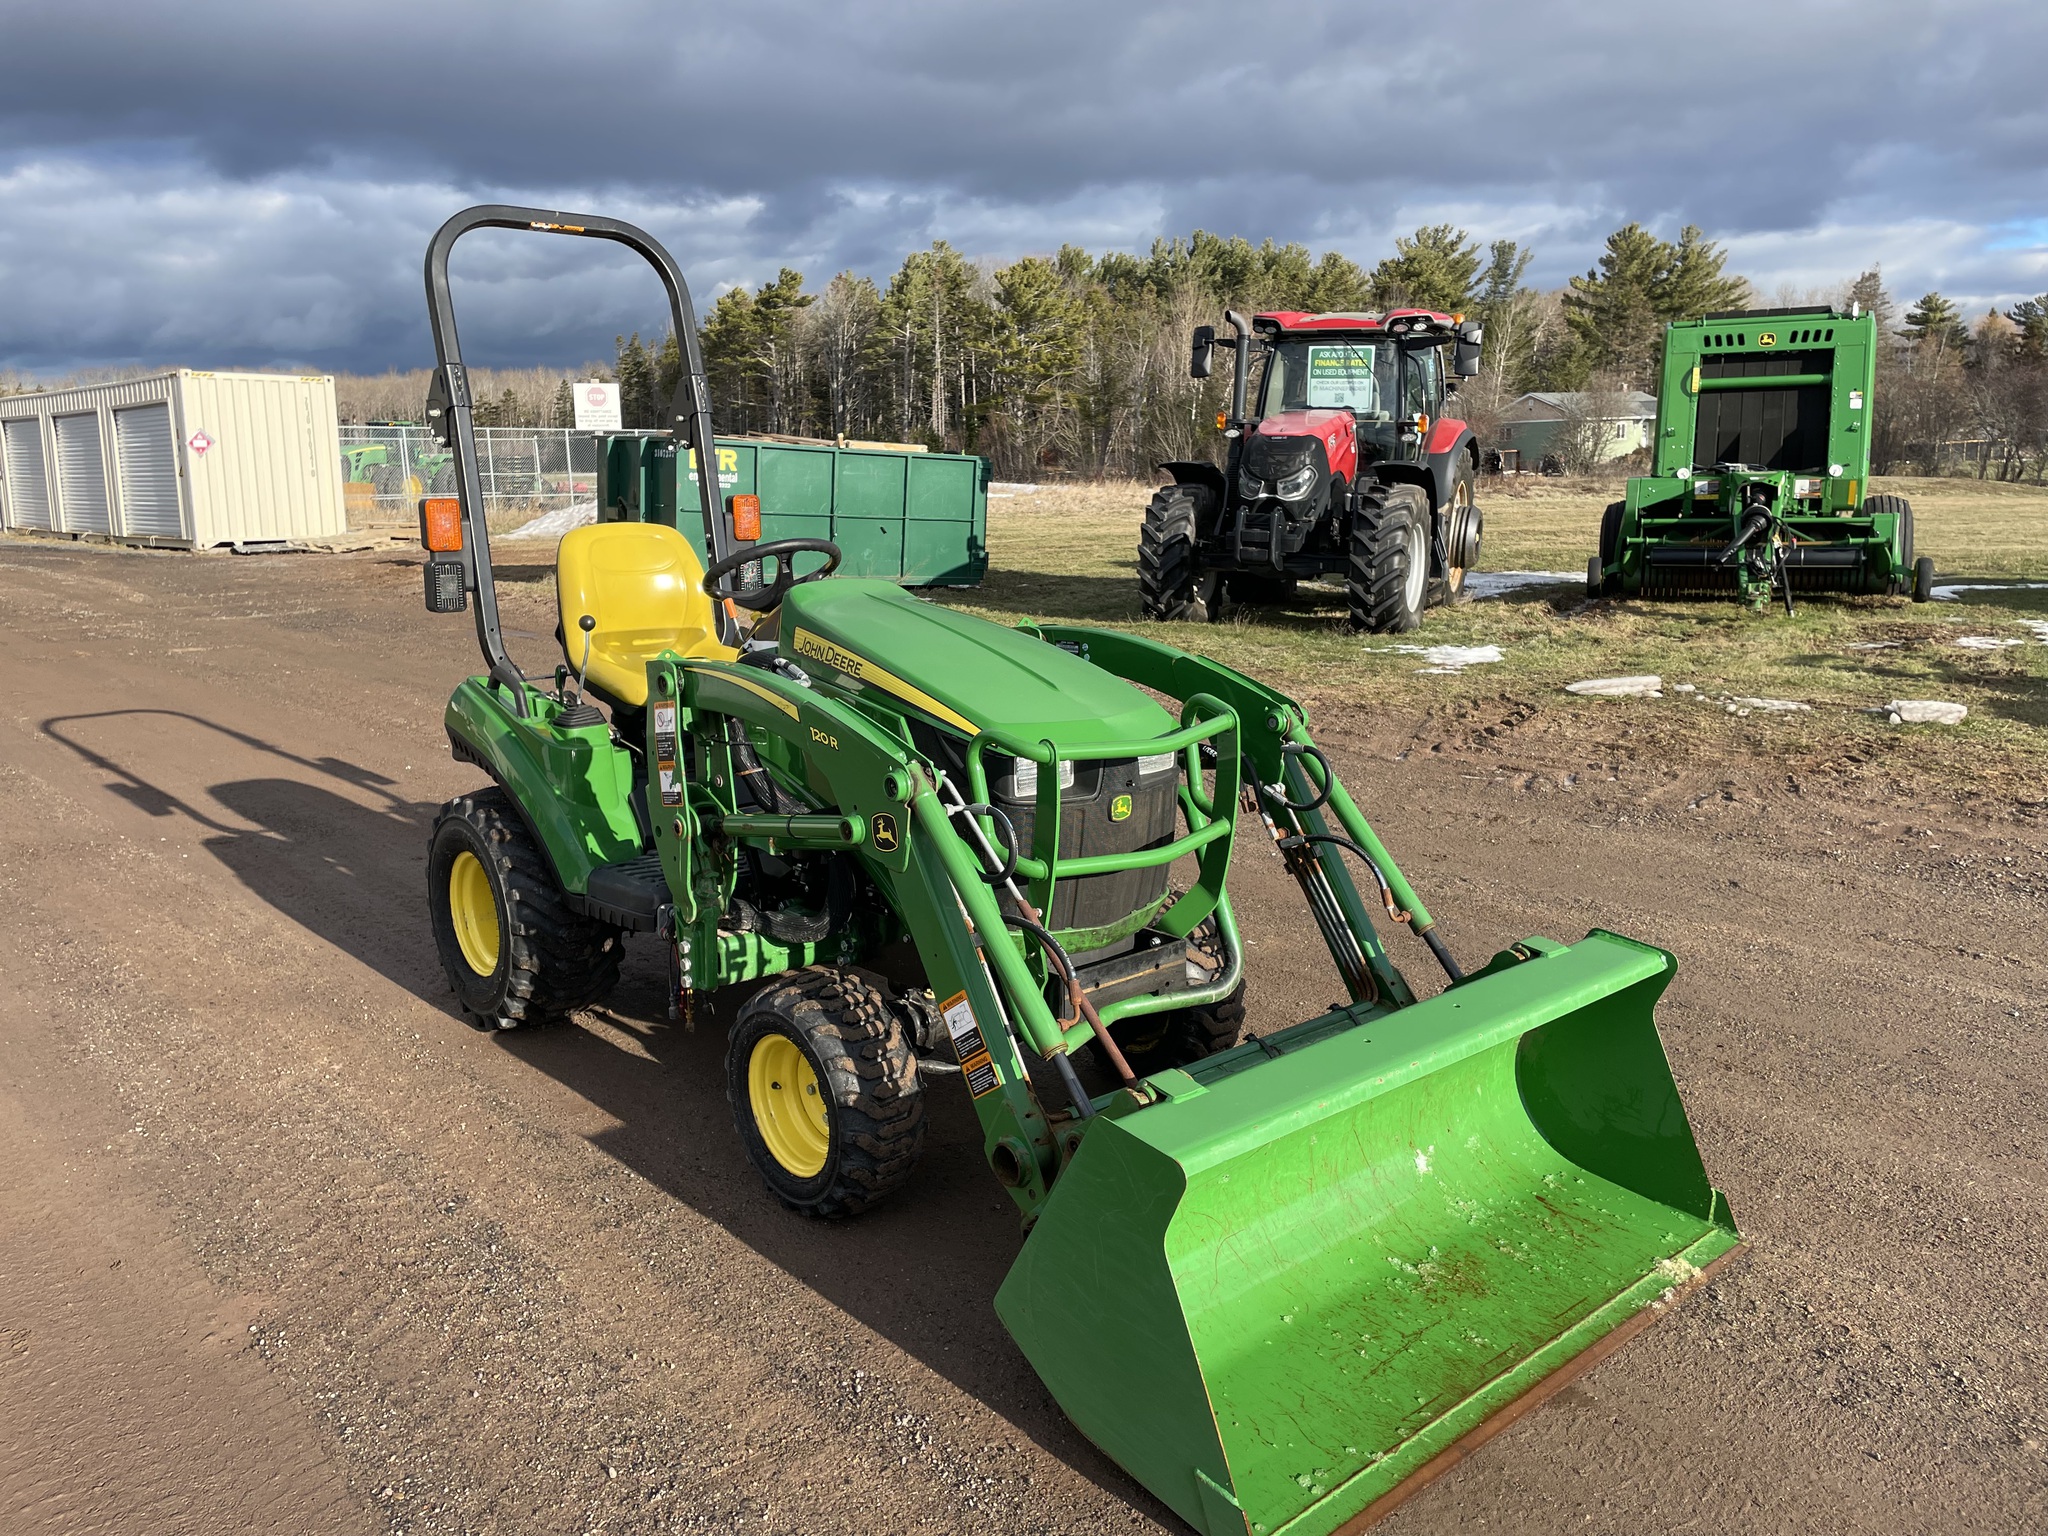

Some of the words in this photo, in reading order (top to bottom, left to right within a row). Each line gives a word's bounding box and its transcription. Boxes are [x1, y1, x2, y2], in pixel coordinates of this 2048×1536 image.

[798, 636, 825, 662] JOHN
[824, 645, 863, 677] DEERE
[946, 994, 964, 1008] WARNING
[970, 1057, 988, 1069] WARNING
